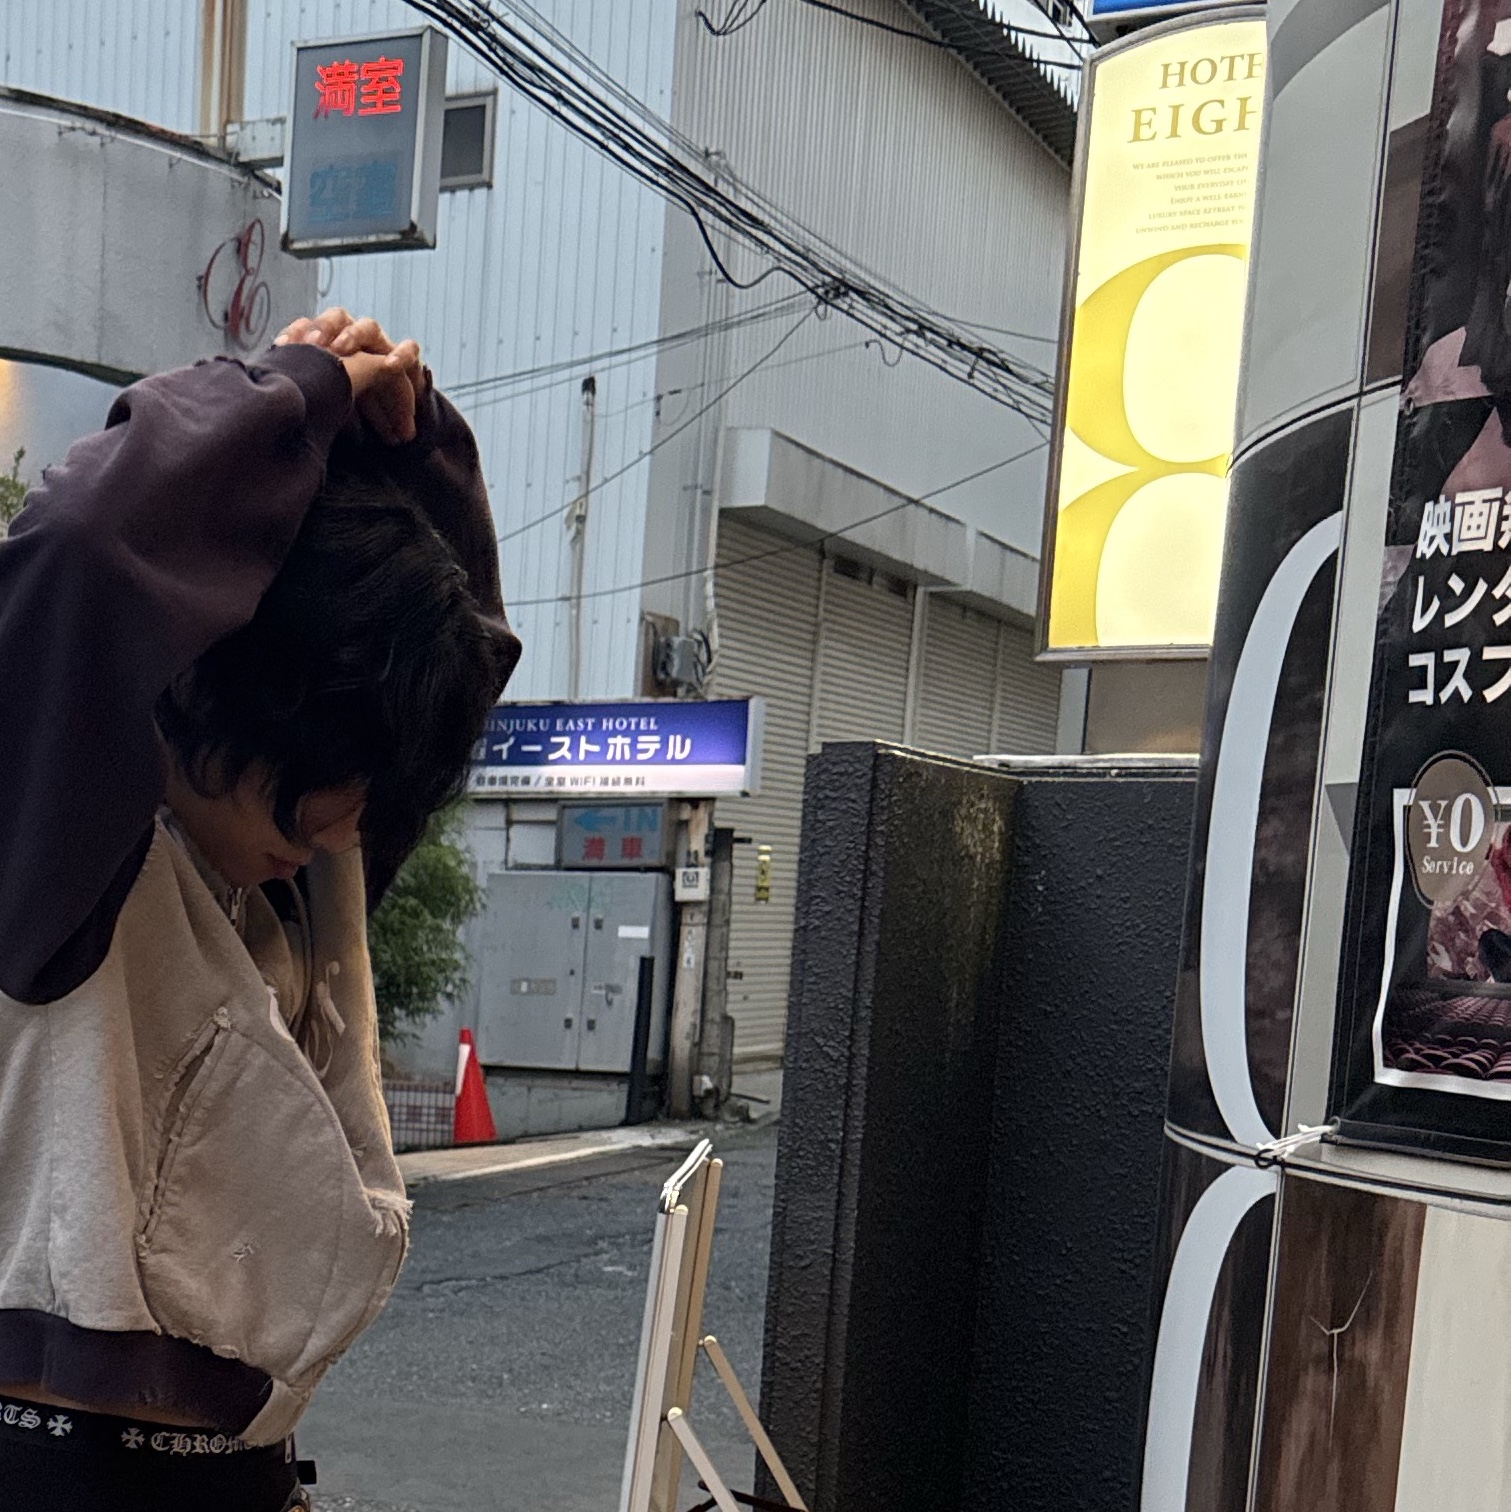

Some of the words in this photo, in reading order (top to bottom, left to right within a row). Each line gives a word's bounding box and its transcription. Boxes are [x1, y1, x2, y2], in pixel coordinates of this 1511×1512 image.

[313, 56, 405, 120] 満室
[555, 718, 595, 732] EAST
[602, 717, 658, 731] HOTEL
[623, 809, 659, 831] IN
[1421, 855, 1475, 876] Service
